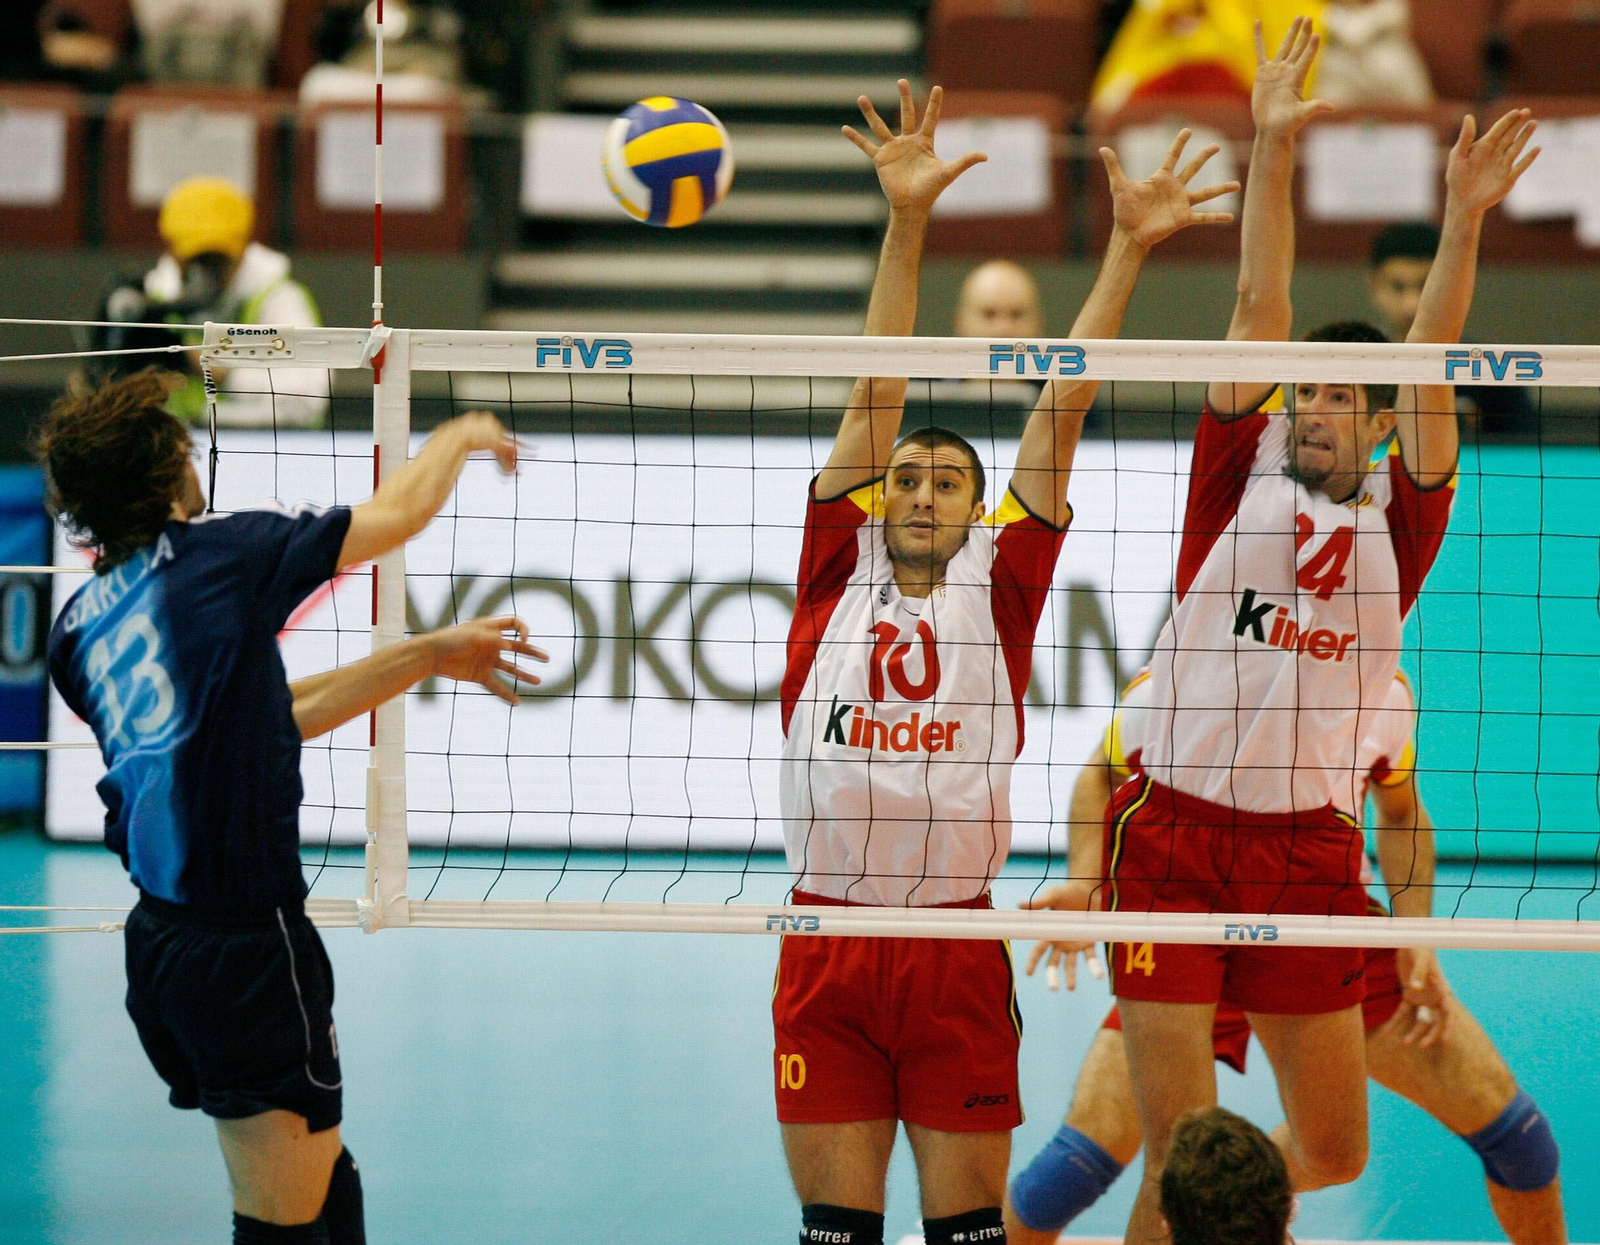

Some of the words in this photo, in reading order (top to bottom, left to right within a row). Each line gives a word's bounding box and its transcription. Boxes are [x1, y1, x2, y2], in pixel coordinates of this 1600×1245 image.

[85, 612, 176, 750] 13
[866, 619, 942, 702] 10
[1122, 942, 1156, 977] 14
[778, 1053, 807, 1090] 10
